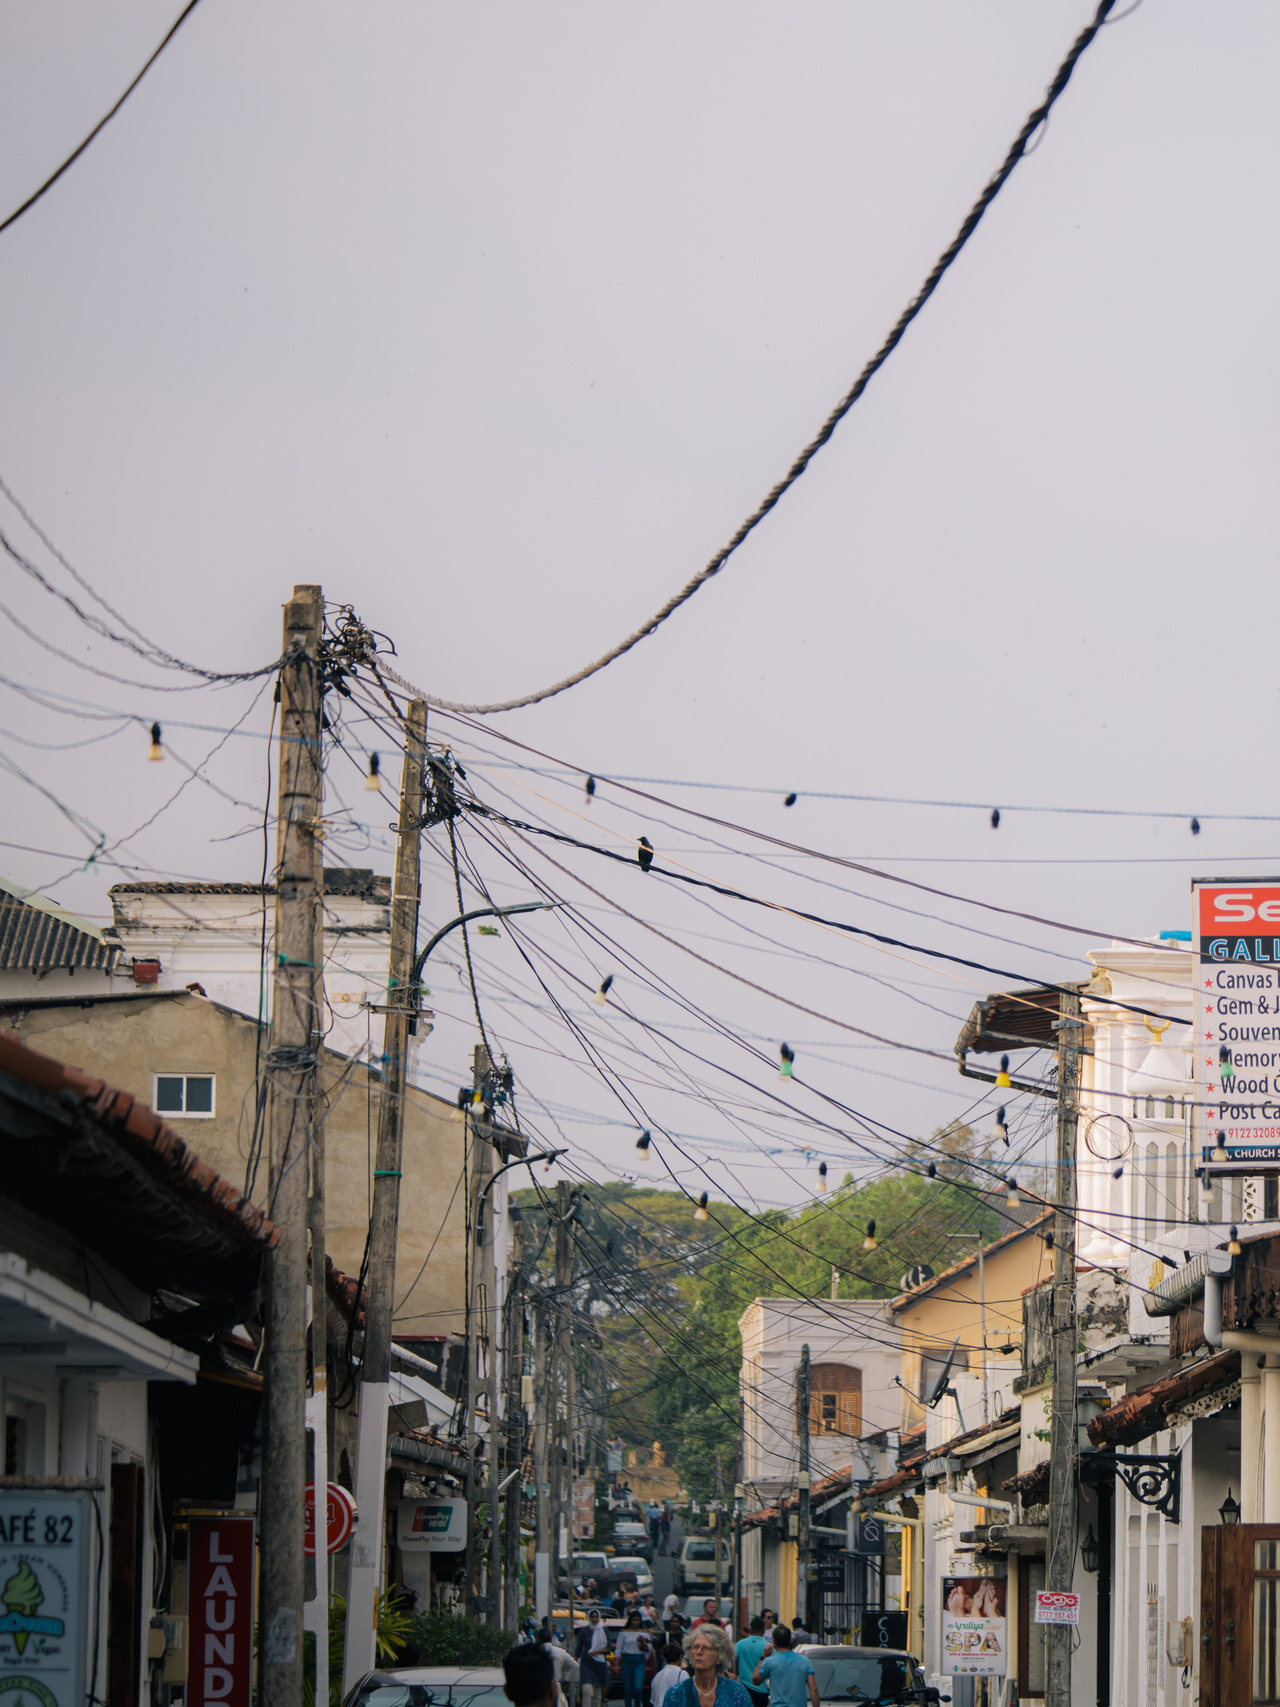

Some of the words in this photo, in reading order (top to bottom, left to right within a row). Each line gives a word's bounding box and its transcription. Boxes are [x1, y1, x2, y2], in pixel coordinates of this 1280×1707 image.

[1216, 970, 1272, 989] Canvas
[1217, 996, 1252, 1014] Gem
[1258, 996, 1269, 1014] &
[1221, 1074, 1268, 1094] Wood
[1220, 1101, 1256, 1120] Post
[1208, 1129, 1225, 1139] +9
[1228, 1128, 1251, 1138] 9122
[1235, 1150, 1276, 1158] CHURCH
[416, 1512, 450, 1521] UnionPay
[45, 1515, 72, 1542] 82
[204, 1531, 238, 1707] LAUND
[944, 1632, 1002, 1652] SPA
